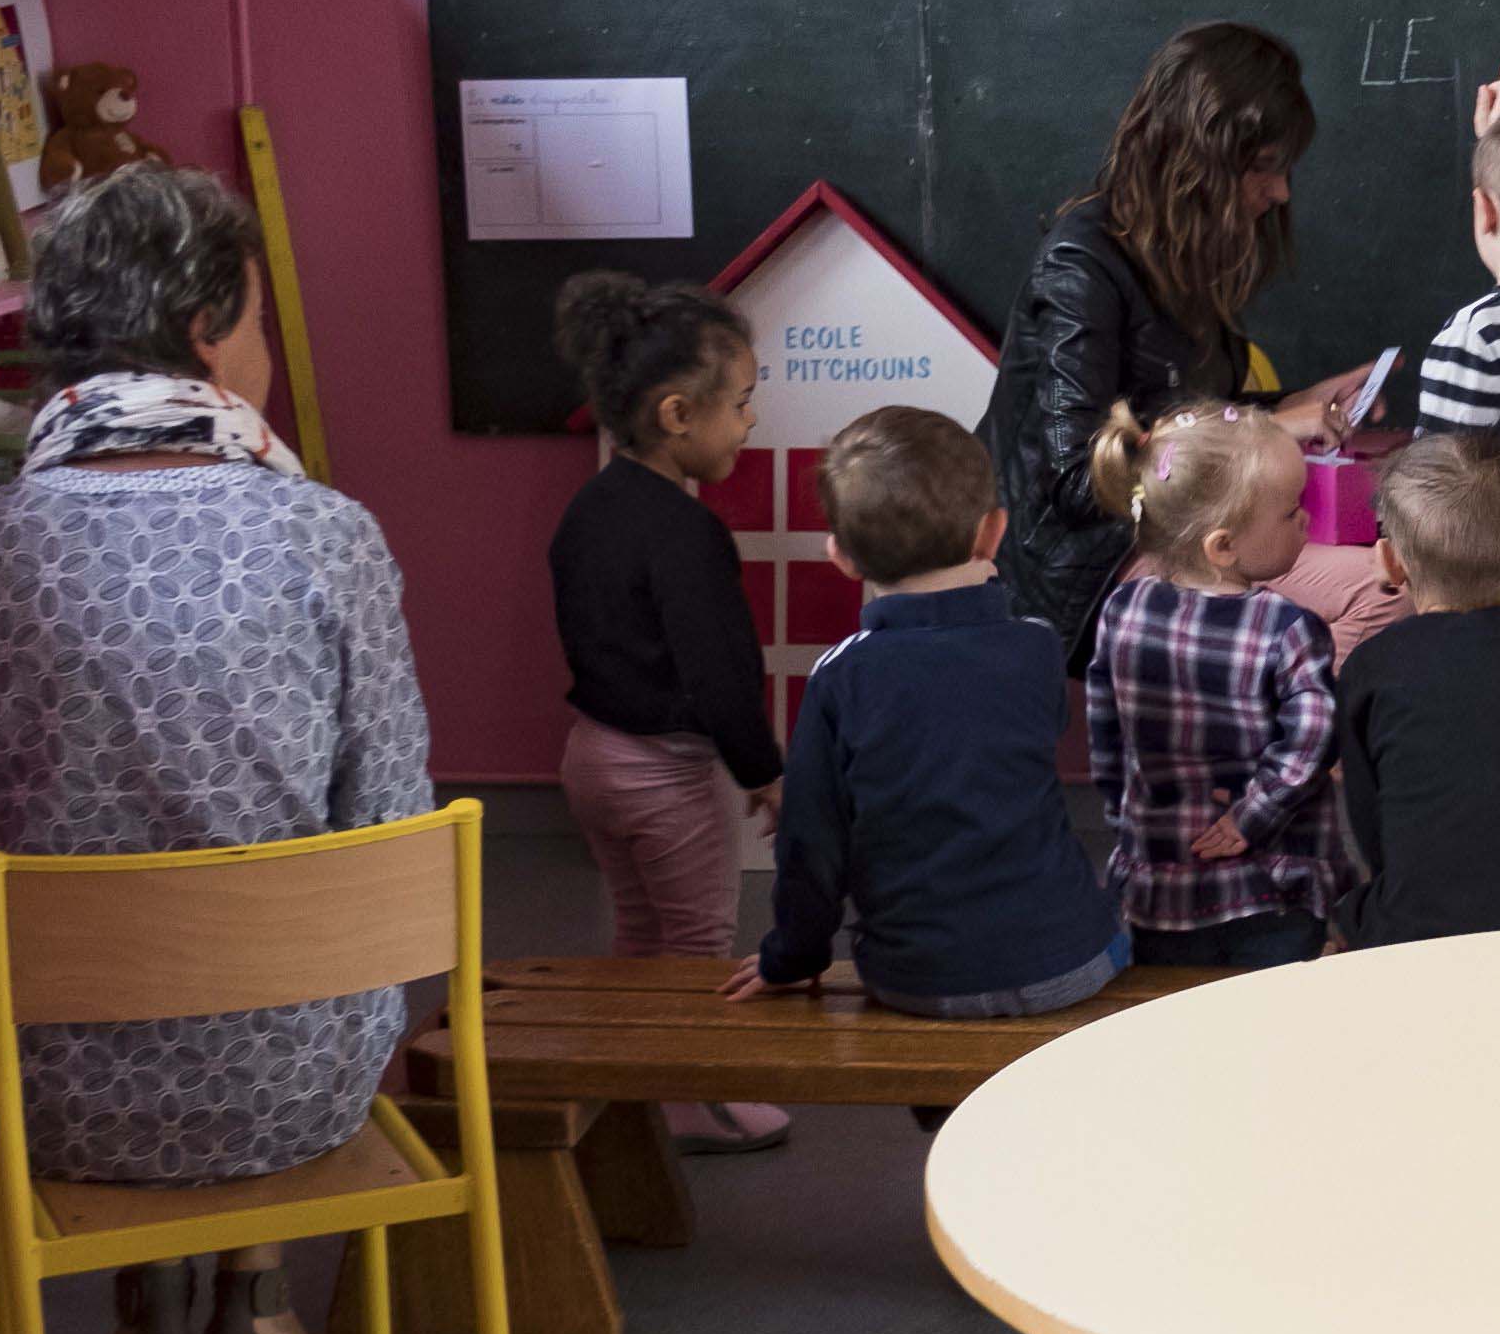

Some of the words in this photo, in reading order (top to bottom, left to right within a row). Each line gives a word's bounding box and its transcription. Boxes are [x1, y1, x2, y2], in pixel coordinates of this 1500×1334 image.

[1360, 18, 1455, 86] LE
[784, 325, 864, 350] ECOLE
[786, 355, 932, 382] PIT'CHOUNS
